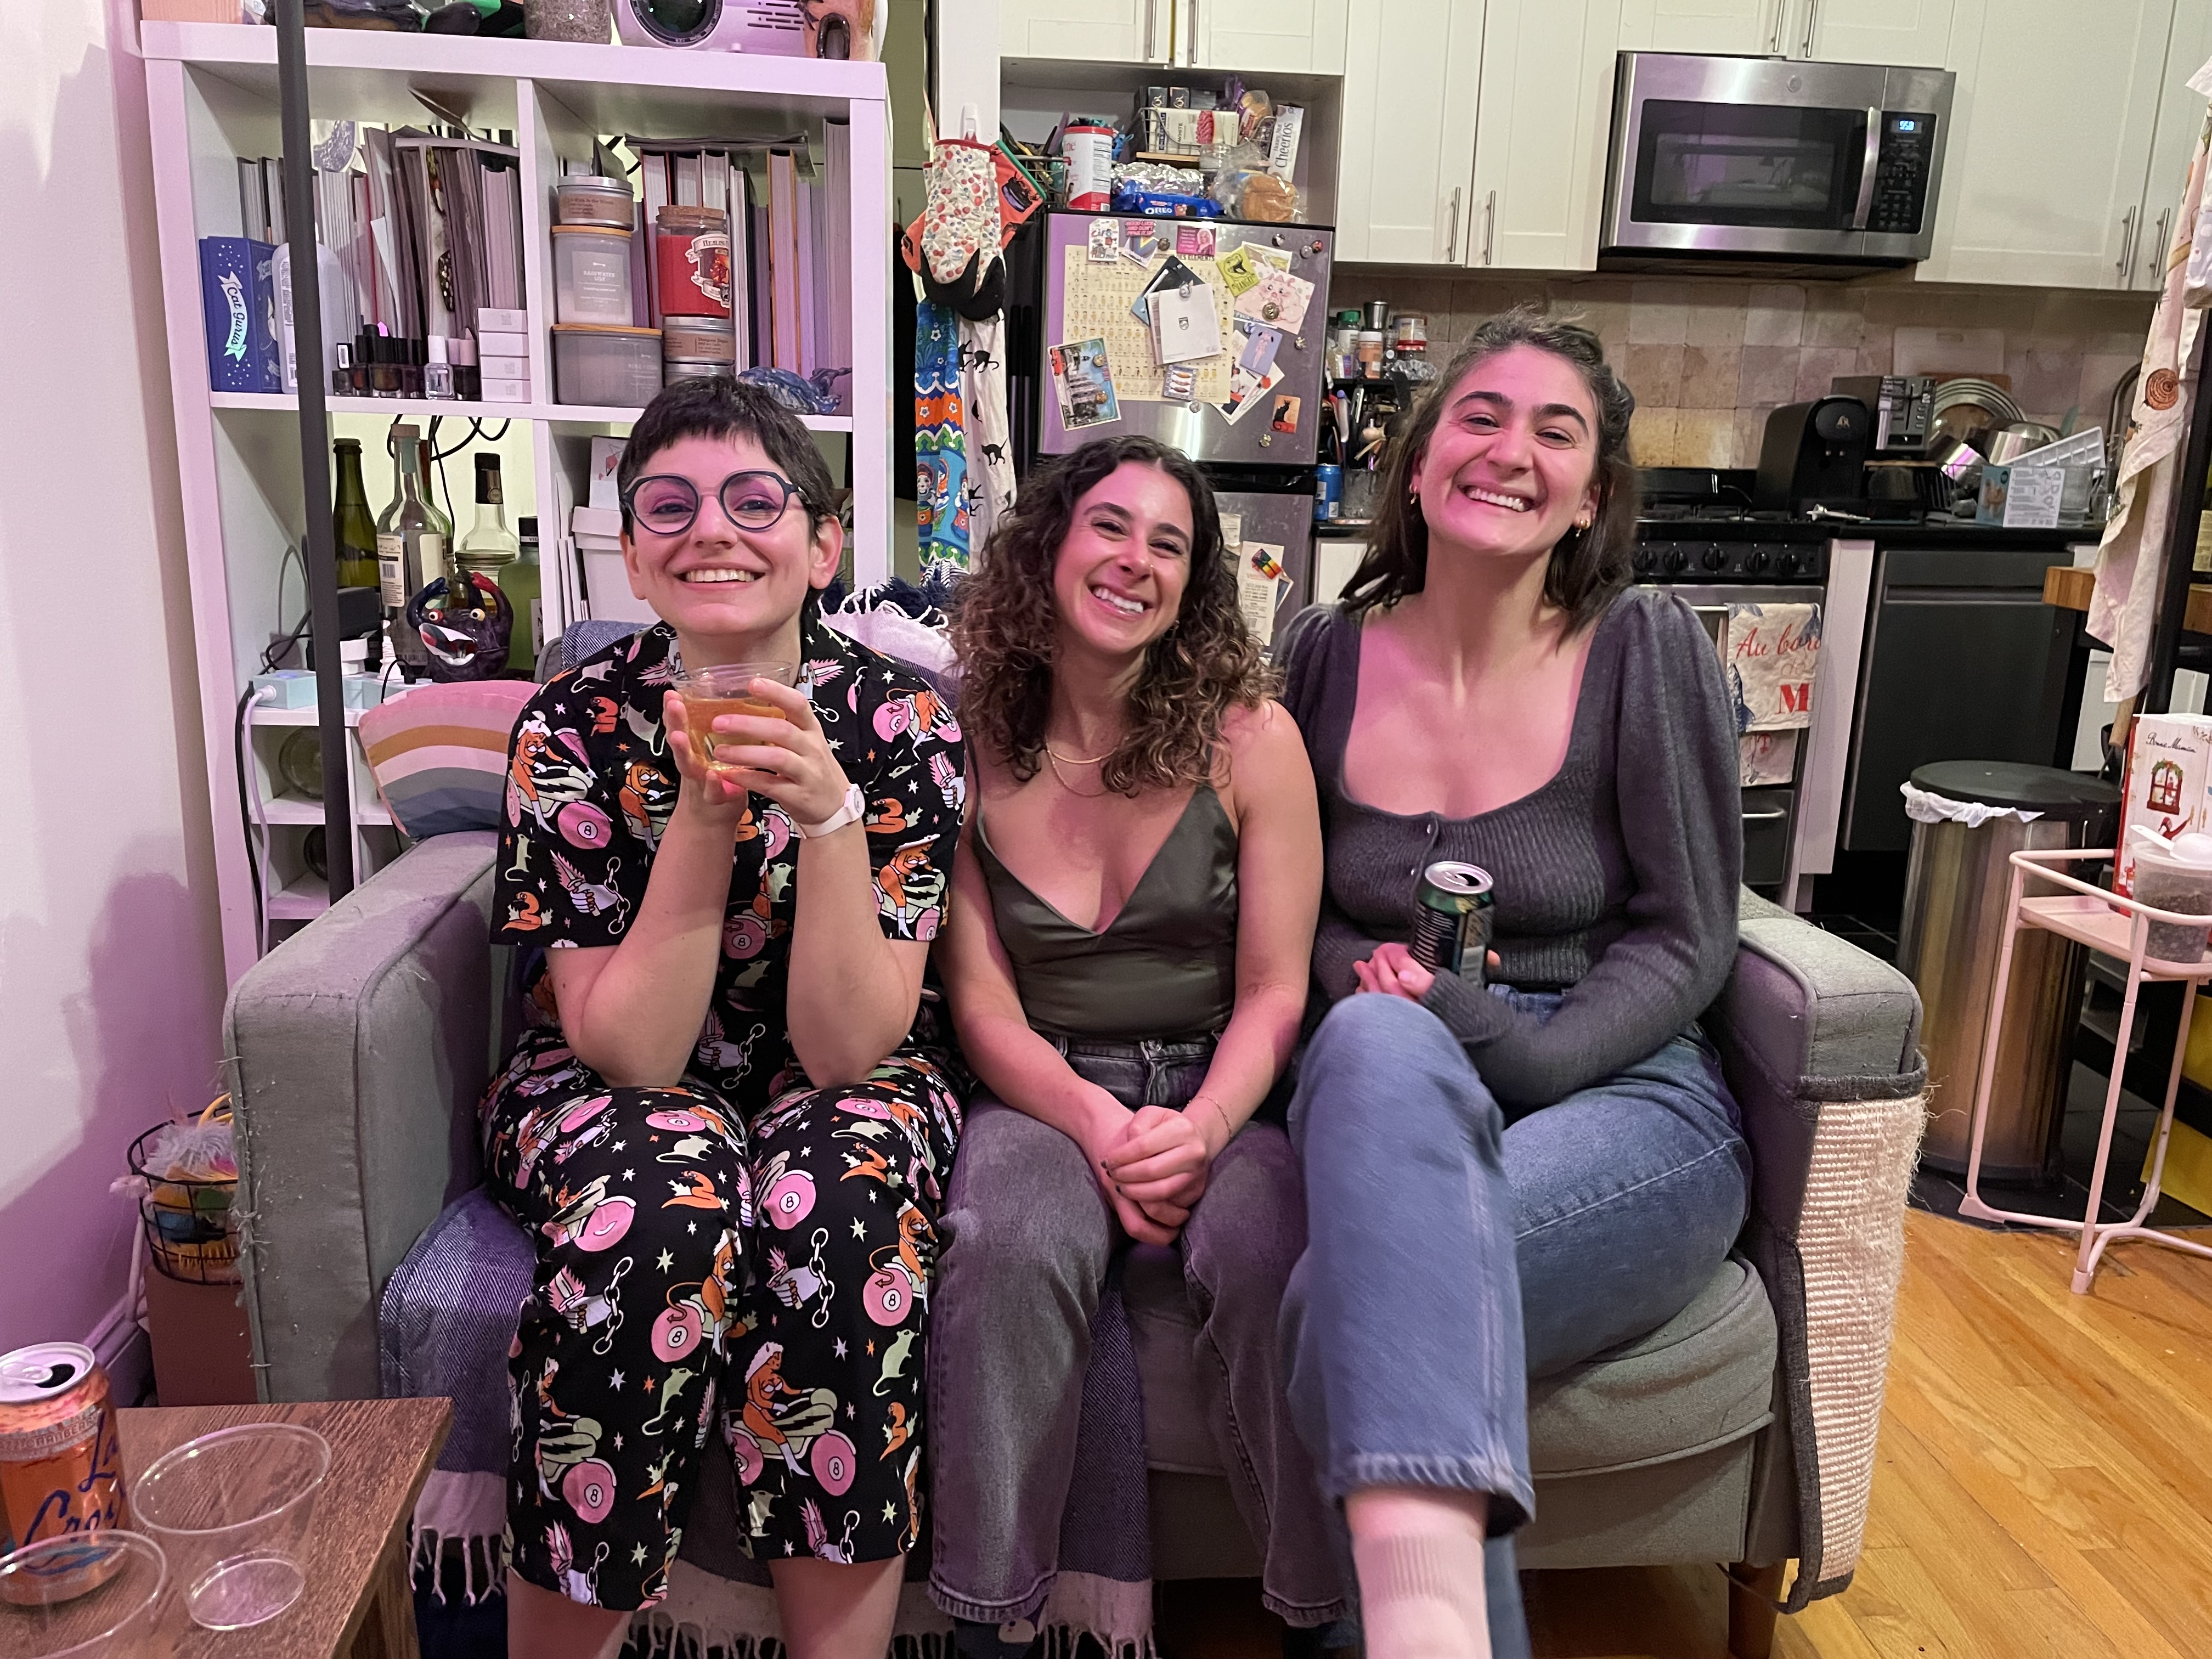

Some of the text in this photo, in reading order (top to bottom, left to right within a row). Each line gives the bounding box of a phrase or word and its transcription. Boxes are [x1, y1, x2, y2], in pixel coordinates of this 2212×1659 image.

[1274, 122, 1294, 168] Cheerios
[1145, 207, 1172, 215] OREO
[227, 287, 242, 309] Cat
[1736, 627, 1767, 659] Au
[1775, 683, 1810, 714] M
[584, 825, 591, 836] 8
[738, 937, 746, 946] 8
[786, 1196, 794, 1208] 8
[888, 1294, 896, 1307] 8
[672, 1330, 682, 1344] 8
[833, 1462, 840, 1476] 8
[590, 1489, 599, 1503] 8
